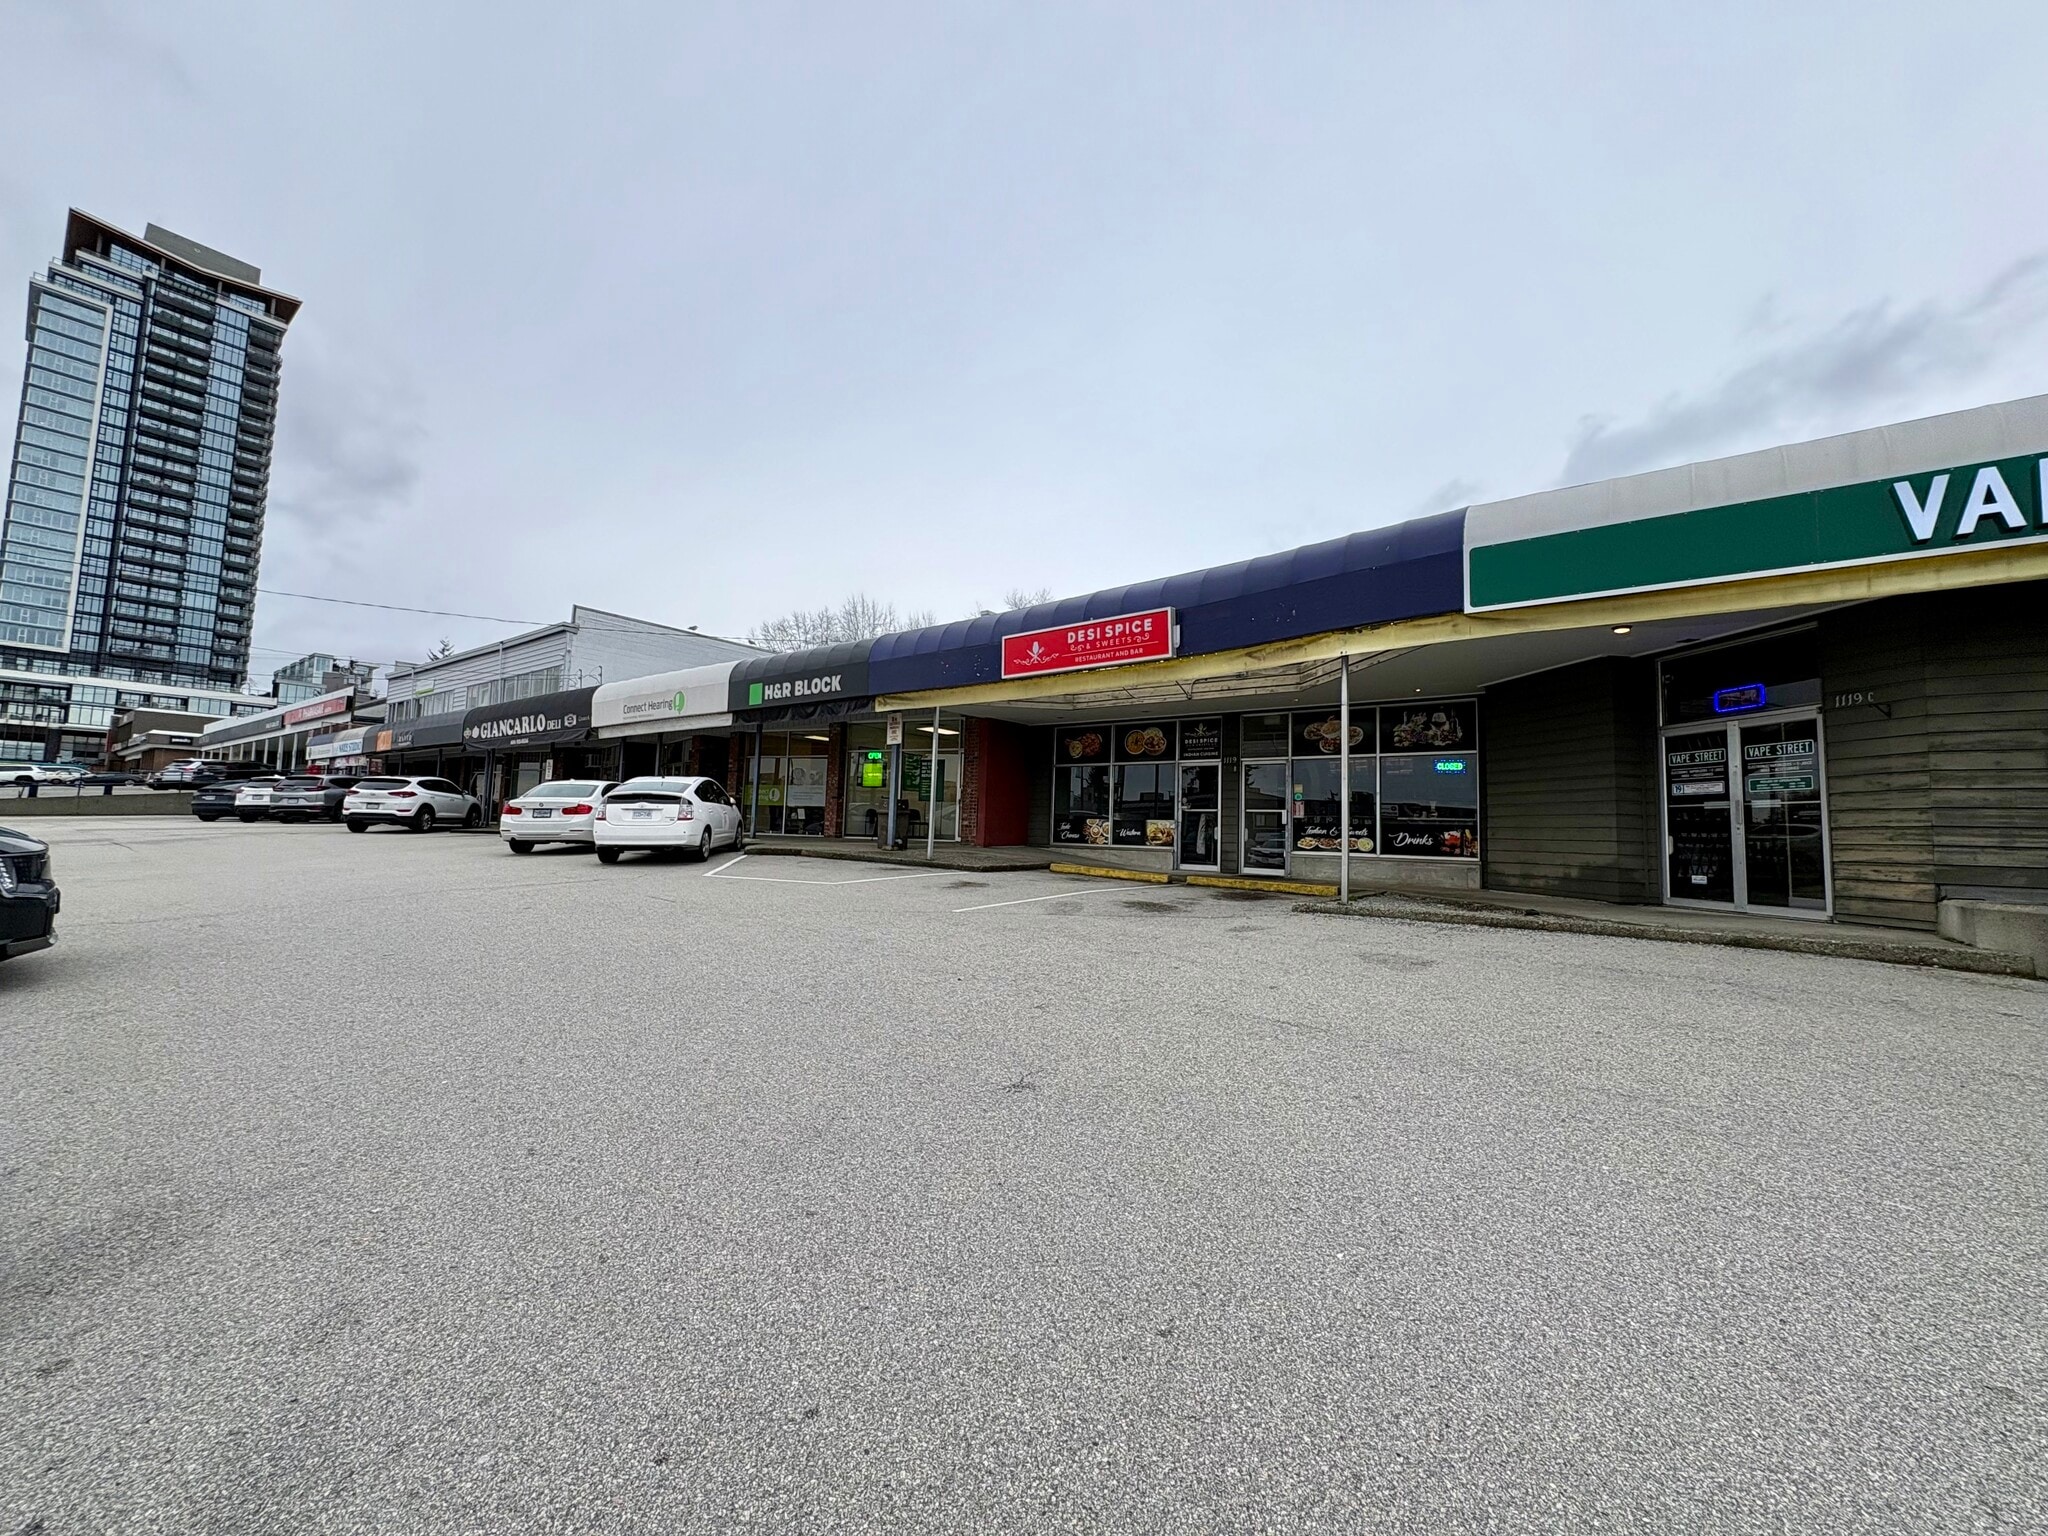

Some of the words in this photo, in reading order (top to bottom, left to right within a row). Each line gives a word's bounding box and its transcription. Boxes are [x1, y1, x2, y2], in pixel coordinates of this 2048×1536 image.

[1893, 458, 2048, 541] VA
[1067, 627, 1100, 644] DESI
[1105, 618, 1153, 638] SPICE
[1096, 636, 1132, 647] SWEETS
[1075, 651, 1114, 663] RESTAURANT
[1115, 650, 1129, 658] AND
[1130, 648, 1144, 656] BAR
[764, 682, 791, 700] H&R
[795, 674, 842, 697] BLOCK
[623, 701, 647, 715] Connect
[648, 698, 673, 711] Hearing
[1835, 692, 1862, 708] 1119
[480, 713, 546, 739] GIANCARLO
[546, 719, 561, 730] DELI
[1671, 752, 1690, 764] VAPE
[1694, 750, 1723, 762] STREET
[1748, 745, 1771, 758] VAPE
[1776, 741, 1810, 755] STREET
[1437, 762, 1463, 770] CLOSED
[1388, 832, 1433, 847] Drinks
